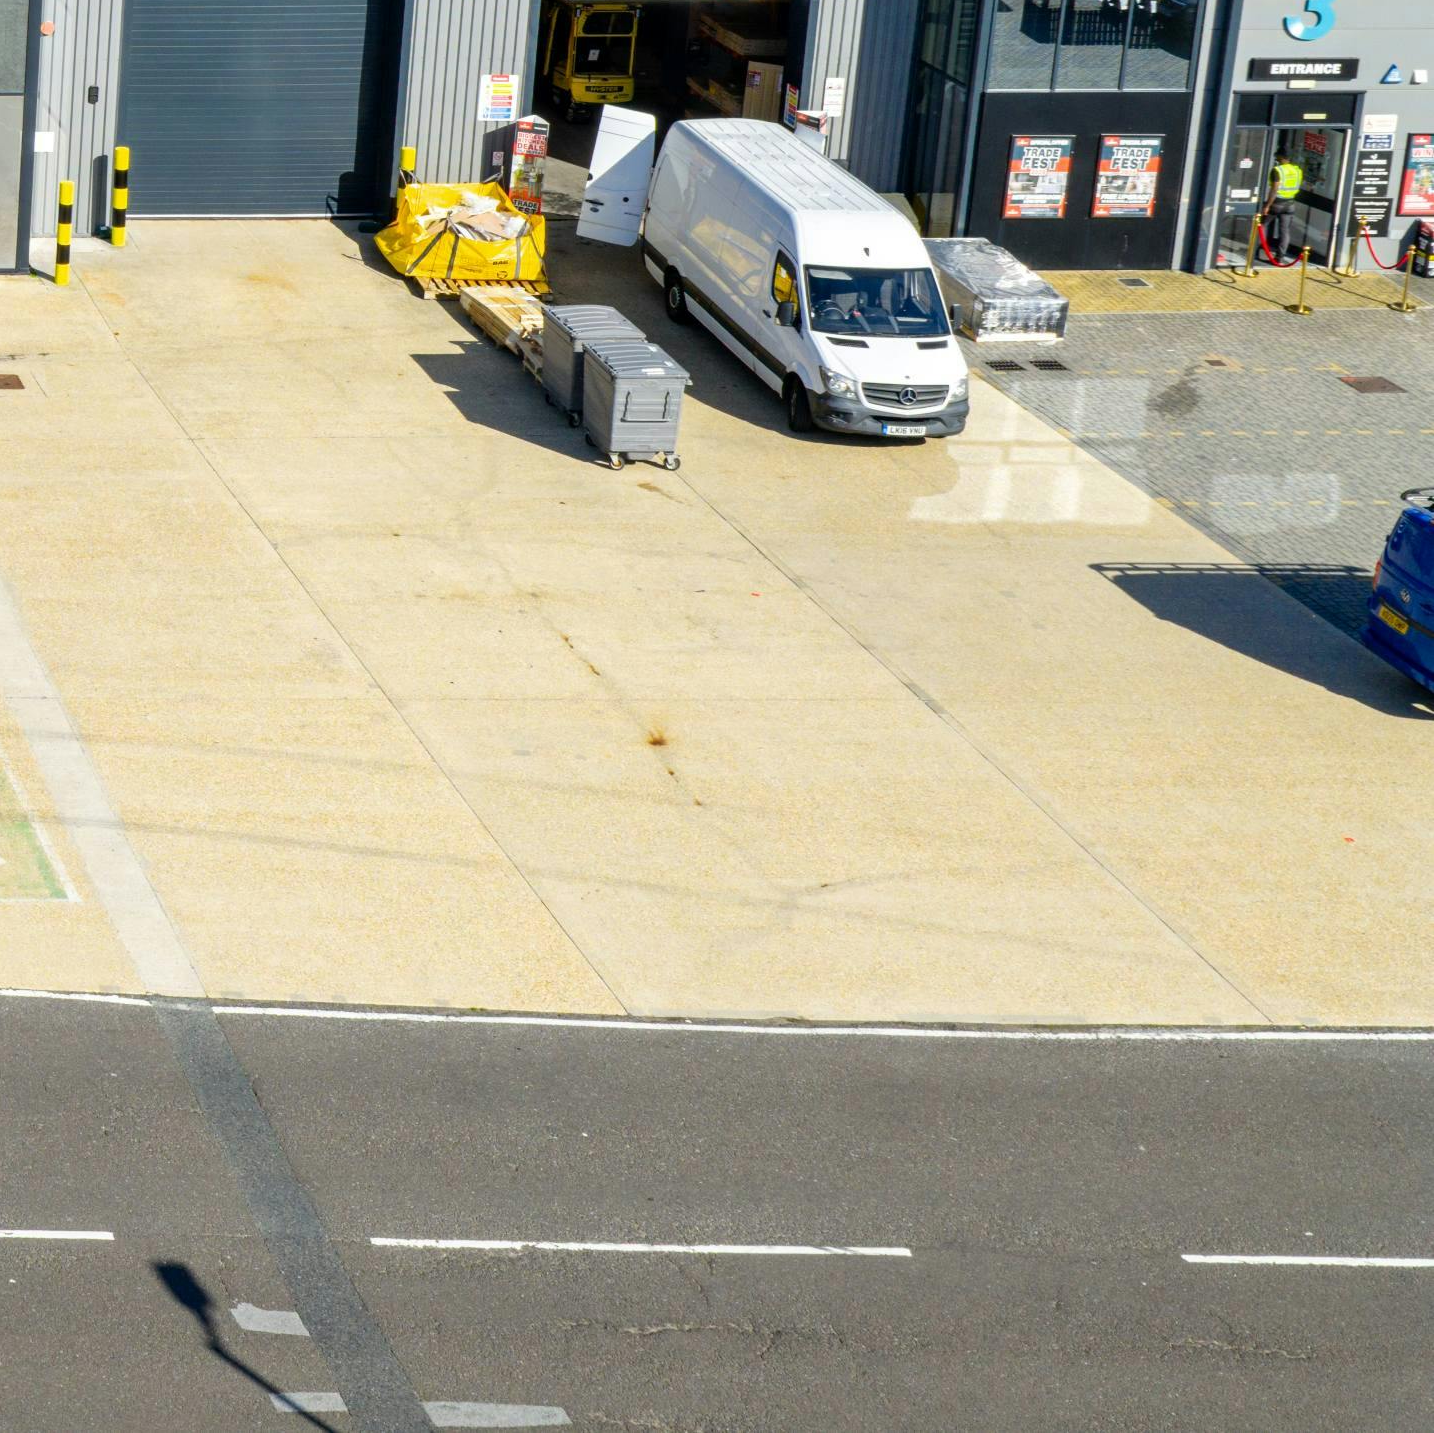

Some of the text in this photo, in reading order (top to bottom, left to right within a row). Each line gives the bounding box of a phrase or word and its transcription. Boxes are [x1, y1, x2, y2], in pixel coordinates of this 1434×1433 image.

[1270, 64, 1341, 74] ENTRANCE
[517, 143, 545, 151] DEALS
[1025, 148, 1060, 157] TRADE
[1114, 148, 1150, 157] TRADE
[1022, 157, 1058, 169] FEST
[1111, 157, 1148, 169] FEST
[514, 199, 538, 209] TRADE
